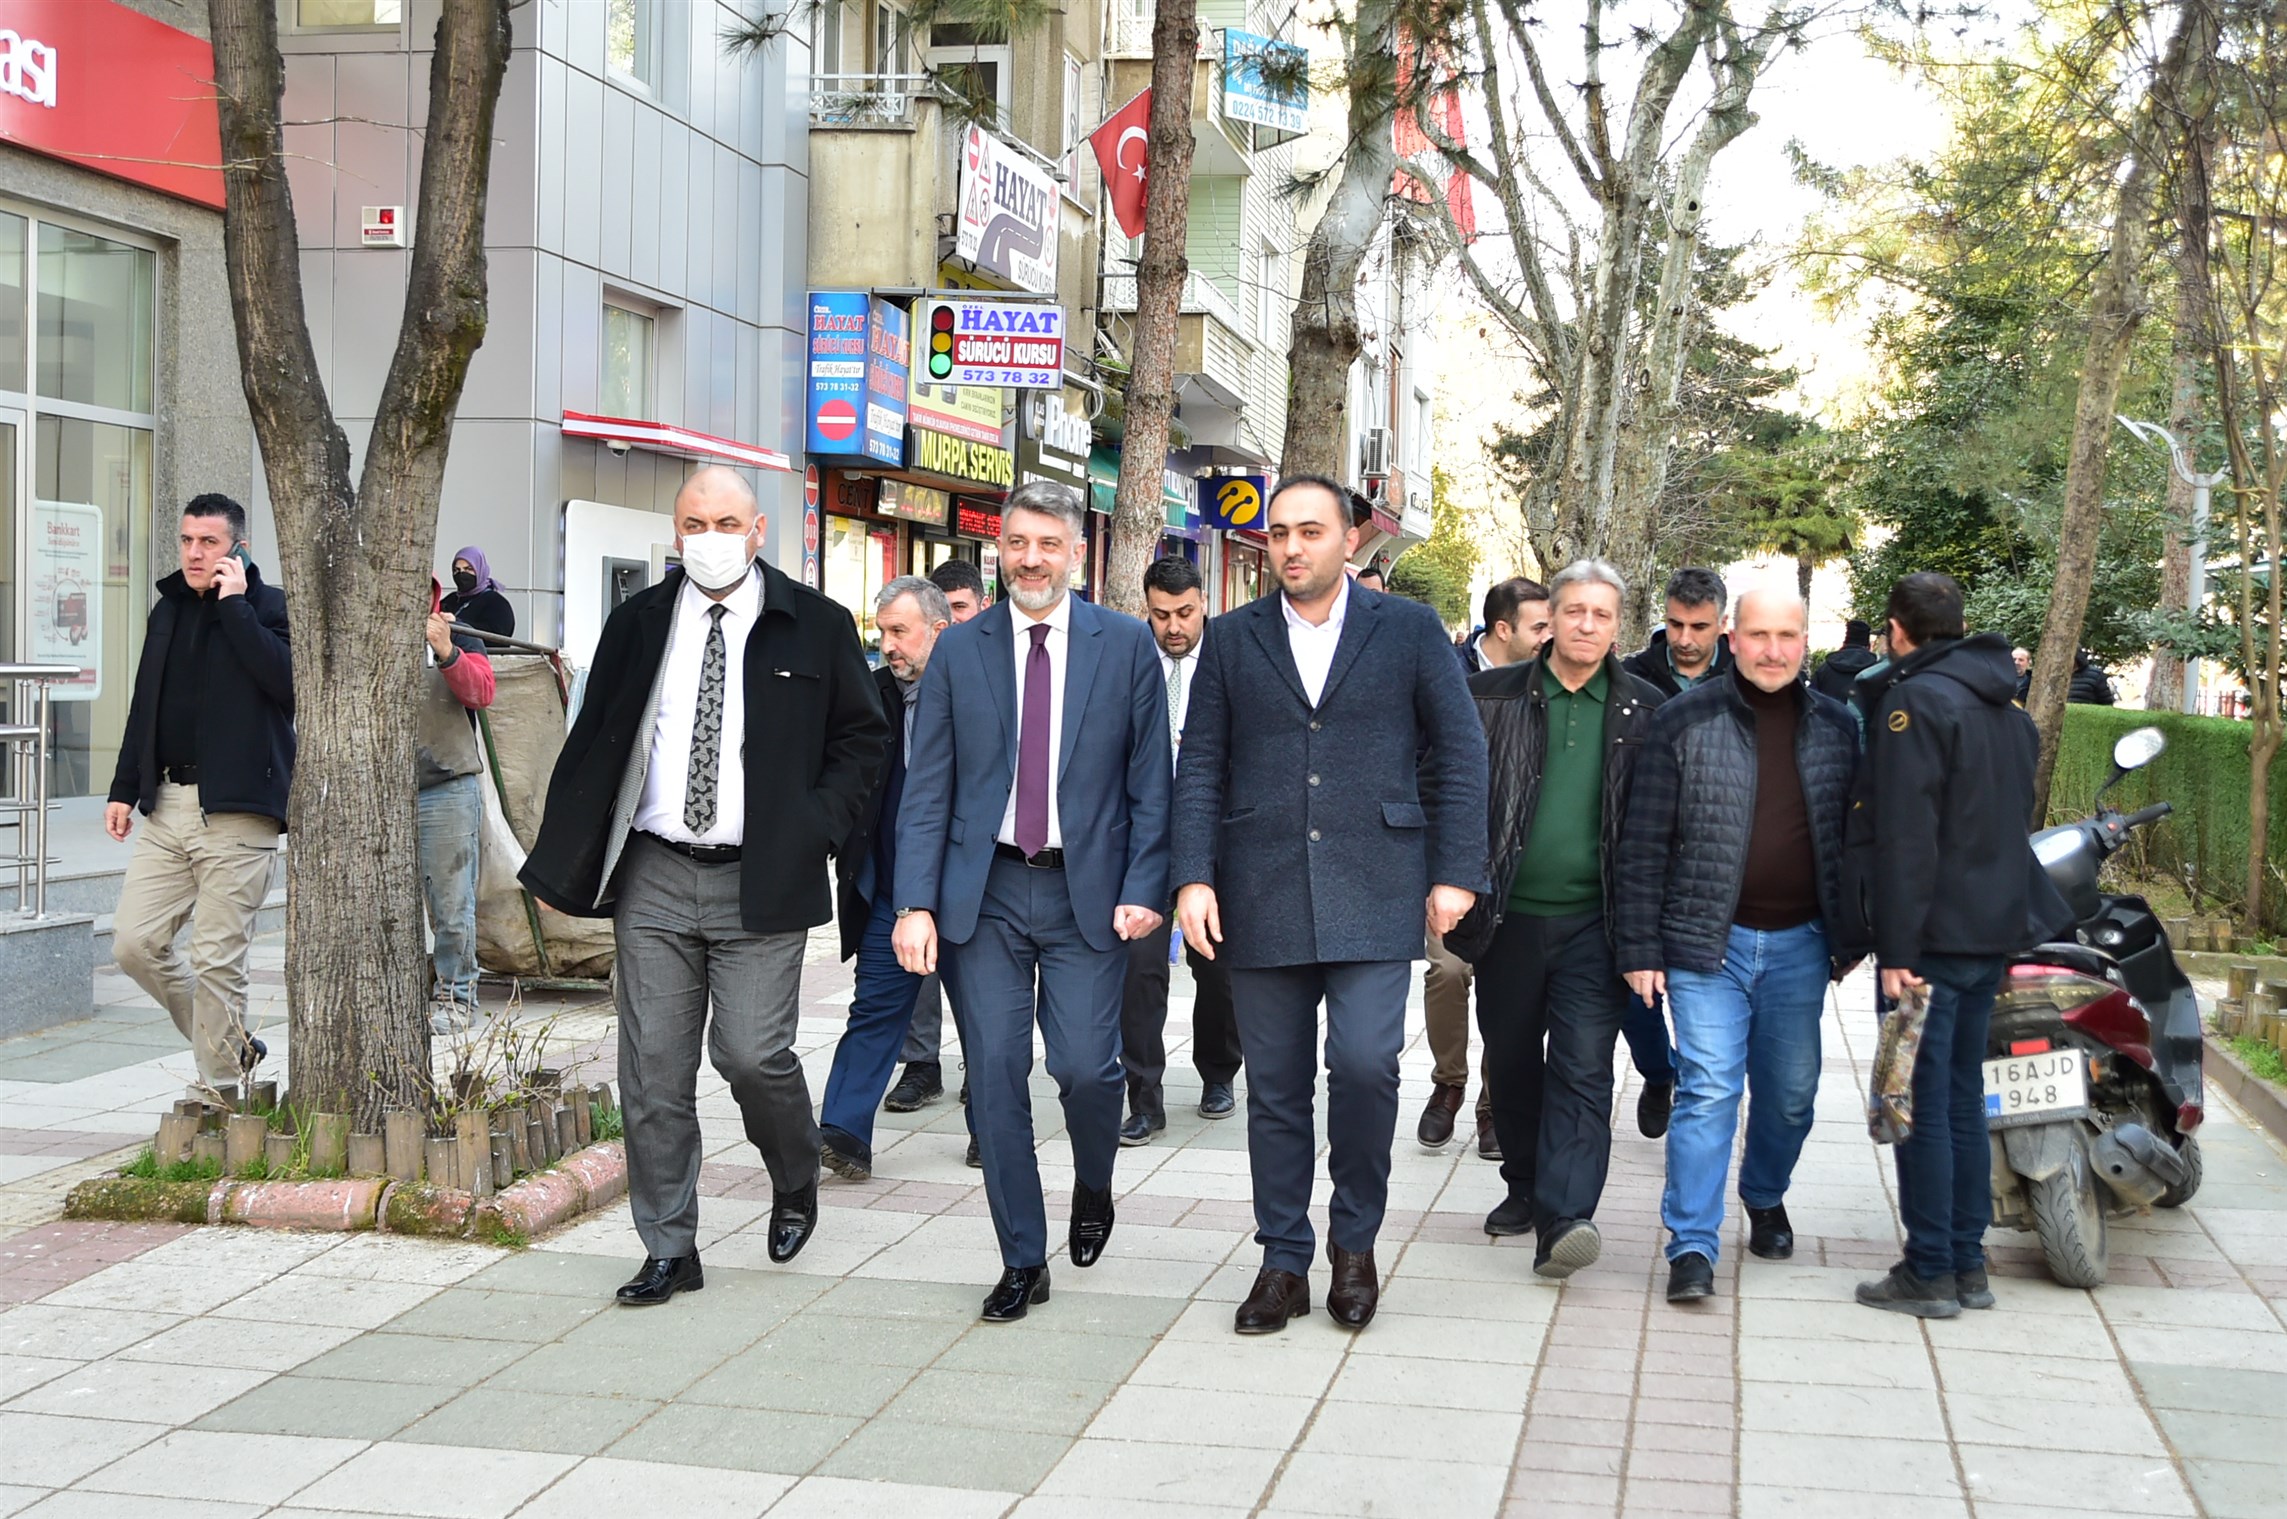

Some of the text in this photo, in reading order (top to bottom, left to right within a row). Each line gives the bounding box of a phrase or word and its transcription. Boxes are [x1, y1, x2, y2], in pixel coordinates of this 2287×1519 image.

[1233, 100, 1302, 129] 0224 572 13 39
[994, 161, 1047, 228] HAYAT
[813, 315, 865, 331] HAYAT
[961, 309, 1057, 333] HAYAT
[871, 325, 910, 368] HAYAT
[958, 336, 1057, 366] SÜRÜCÜ KURSU
[816, 382, 860, 392] 573 78 31-32
[963, 369, 1050, 384] 573 78 32
[869, 438, 900, 461] 573 78 31-32
[921, 429, 968, 477] MURPA
[2009, 1085, 2057, 1108] 948
